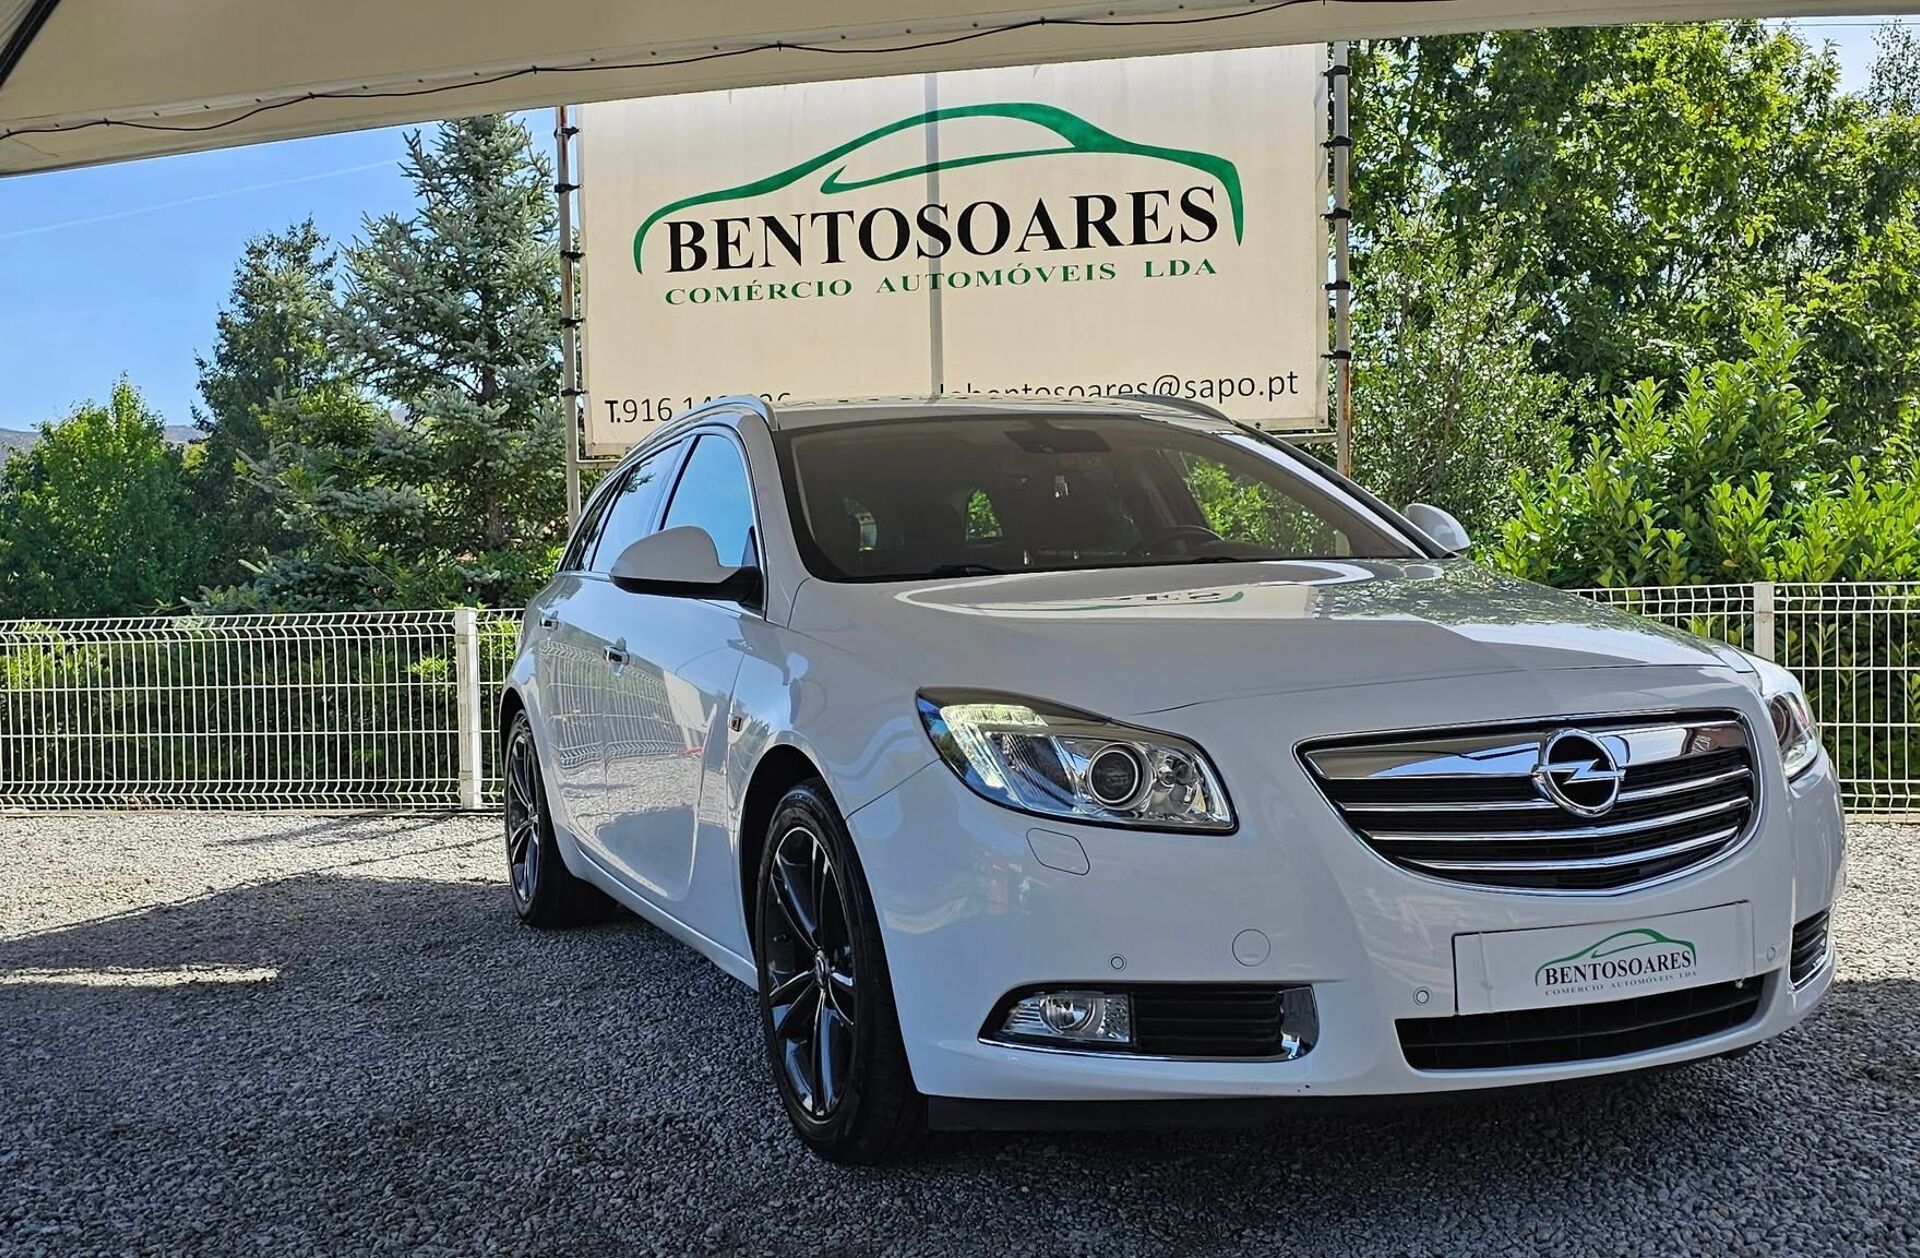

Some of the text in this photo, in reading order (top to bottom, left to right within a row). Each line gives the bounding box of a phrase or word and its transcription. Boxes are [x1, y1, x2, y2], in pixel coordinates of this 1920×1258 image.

[663, 186, 1218, 273] BENTOSOARES
[665, 258, 1218, 305] COMÉRCIO AUTOMÓVEIS LDA
[604, 398, 673, 423] T.916
[1545, 951, 1691, 986] BENTOSOARES
